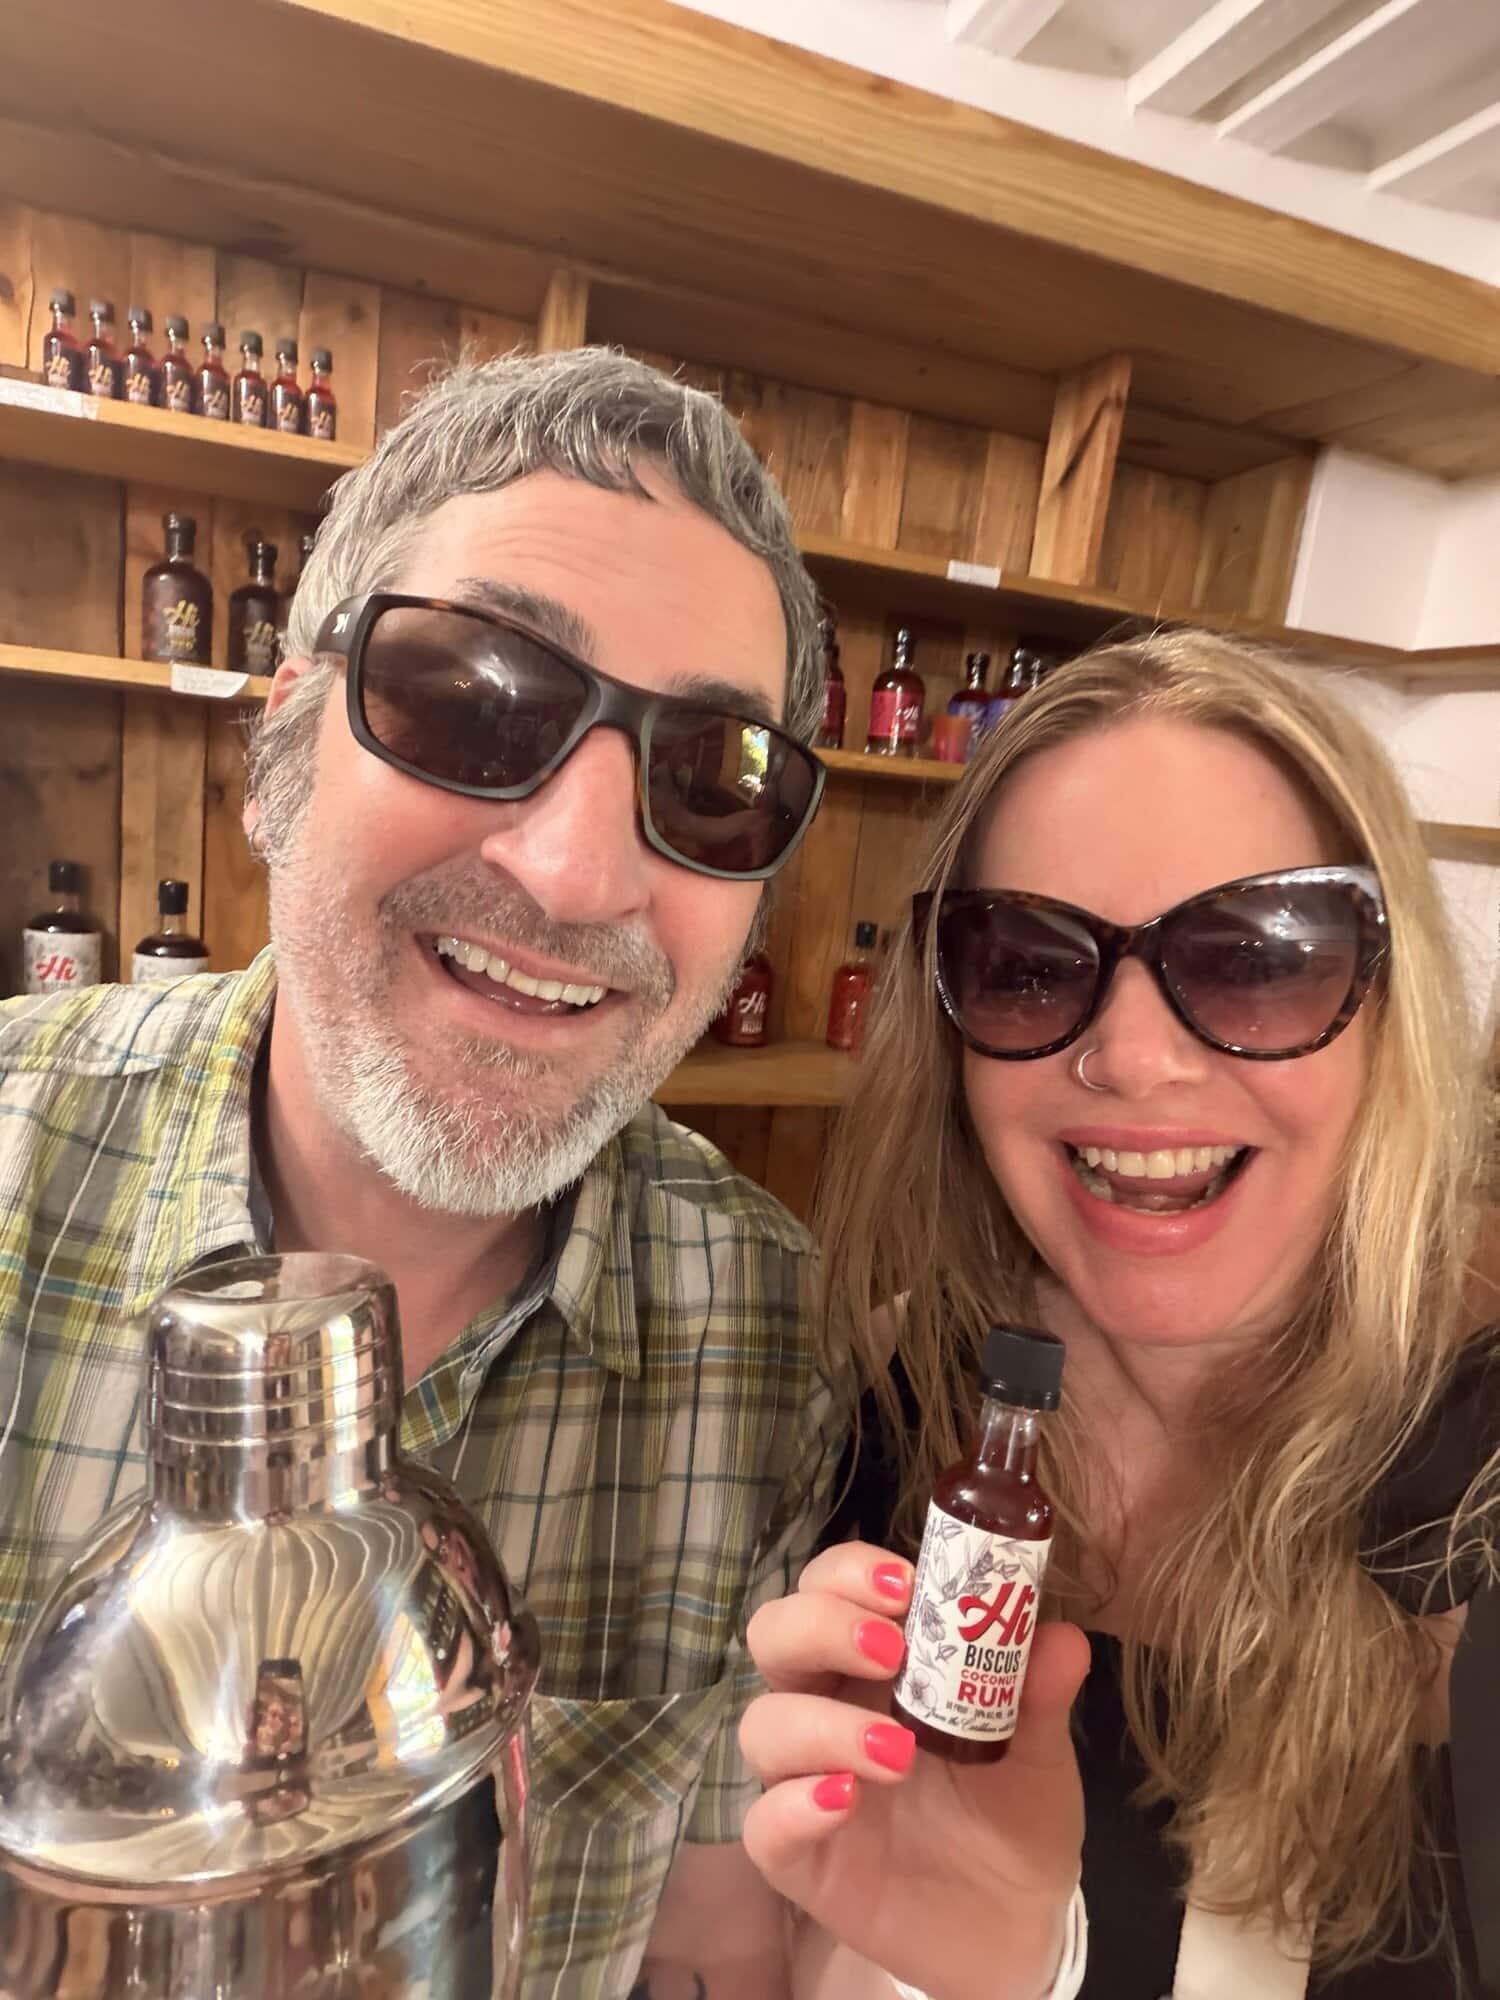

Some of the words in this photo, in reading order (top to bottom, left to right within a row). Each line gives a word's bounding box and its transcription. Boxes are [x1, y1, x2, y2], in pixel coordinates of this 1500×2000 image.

[161, 600, 199, 626] Hi
[36, 955, 77, 981] Hi
[958, 1581, 1035, 1646] Hi
[964, 1644, 1021, 1672] BISCUS
[961, 1668, 1016, 1686] COCONUT
[957, 1681, 1014, 1708] RUM
